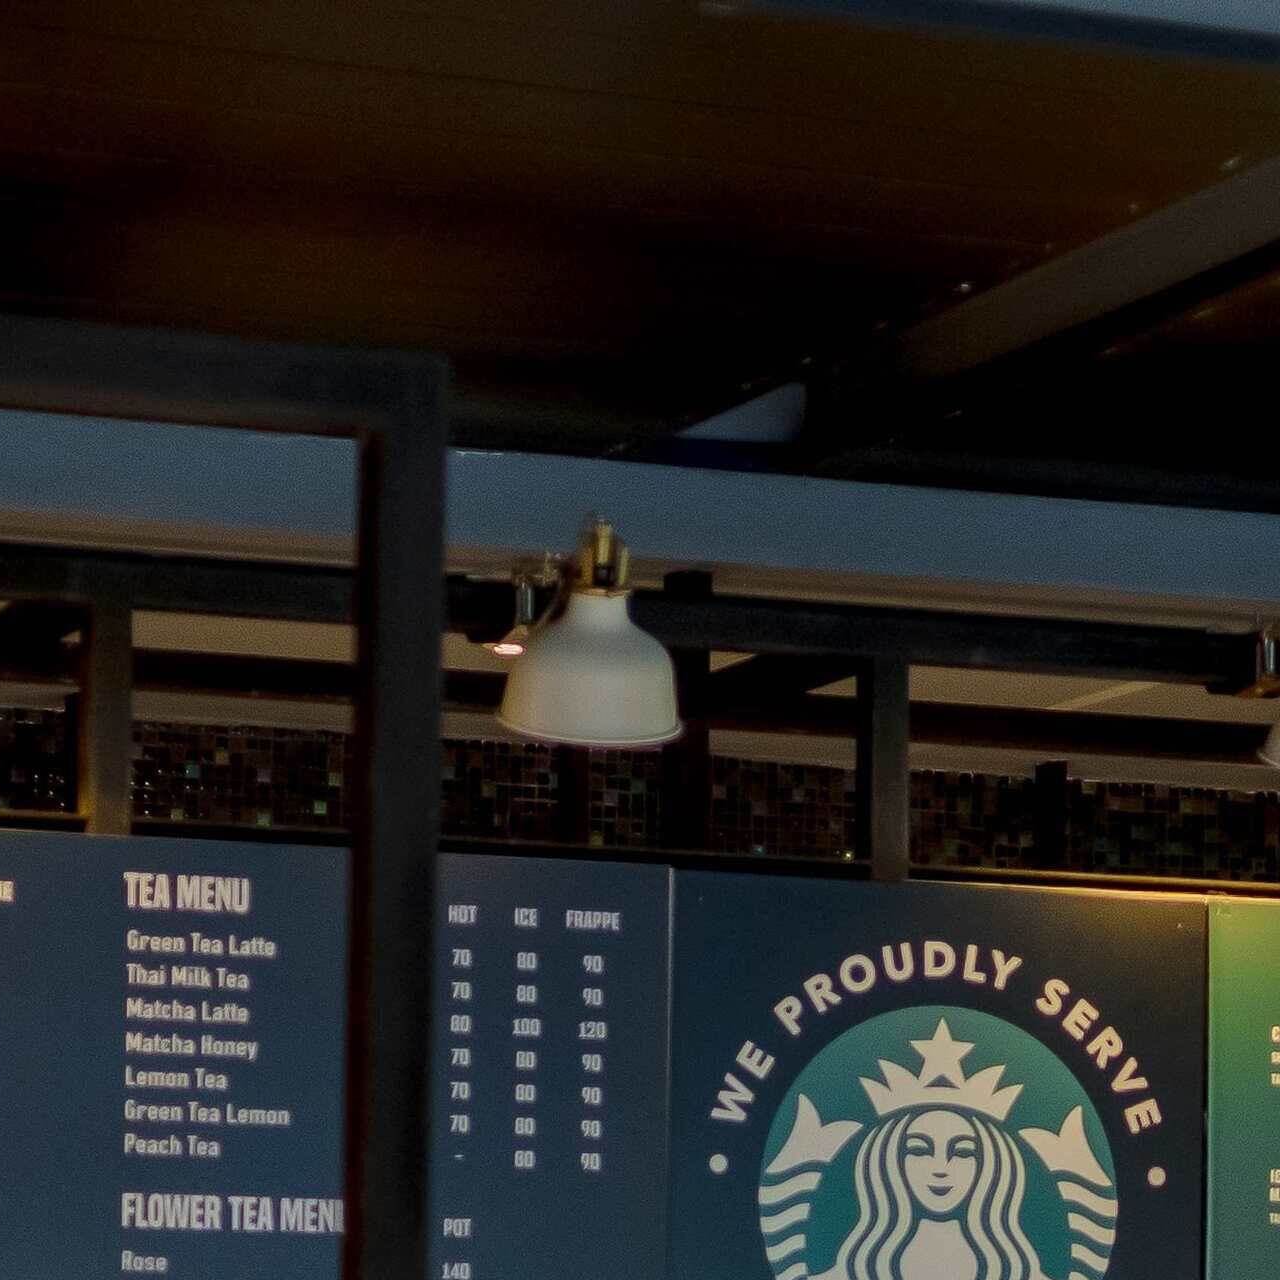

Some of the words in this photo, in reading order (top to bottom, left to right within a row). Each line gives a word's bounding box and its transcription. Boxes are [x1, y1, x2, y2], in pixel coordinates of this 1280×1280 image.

[123, 872, 170, 909] TEA
[176, 875, 251, 914] MENU
[448, 904, 479, 924] HOT
[513, 907, 538, 927] ICE
[565, 909, 621, 931] FRAPPE
[126, 929, 186, 953] Green
[190, 932, 224, 955] Tea
[228, 934, 278, 957] Latte
[452, 948, 472, 967] 70
[582, 955, 604, 973] 90
[125, 963, 166, 986] Thai
[171, 965, 212, 988] Milk
[216, 968, 250, 989] Tea
[451, 981, 472, 999] 70
[582, 988, 603, 1006] 90
[125, 998, 197, 1020] Matcha
[201, 1001, 251, 1023] Latte
[512, 1018, 542, 1036] 100
[578, 1021, 608, 1039] 120
[710, 1039, 778, 1127] WE
[773, 940, 1023, 1037] PROUDLY
[1035, 978, 1164, 1135] SERVE
[125, 1032, 196, 1054] Matcha
[200, 1035, 259, 1061] Honey
[451, 1048, 471, 1066] 70
[581, 1054, 603, 1072] 90
[124, 1065, 190, 1088] Lemon
[195, 1067, 229, 1090] Tea
[449, 1081, 470, 1100] 70
[581, 1087, 602, 1105] 90
[124, 1099, 183, 1121] Green
[188, 1101, 221, 1123] Tea
[226, 1103, 292, 1125] Lemon
[449, 1114, 470, 1133] 70
[580, 1120, 602, 1138] 90
[123, 1132, 183, 1155] Peach
[187, 1135, 221, 1157] Tea
[580, 1153, 602, 1171] 90
[121, 1192, 222, 1231] FLOWER
[227, 1195, 274, 1231] TEA
[443, 1218, 472, 1237] POT
[121, 1250, 169, 1272] Rose
[441, 1262, 471, 1280] 140
